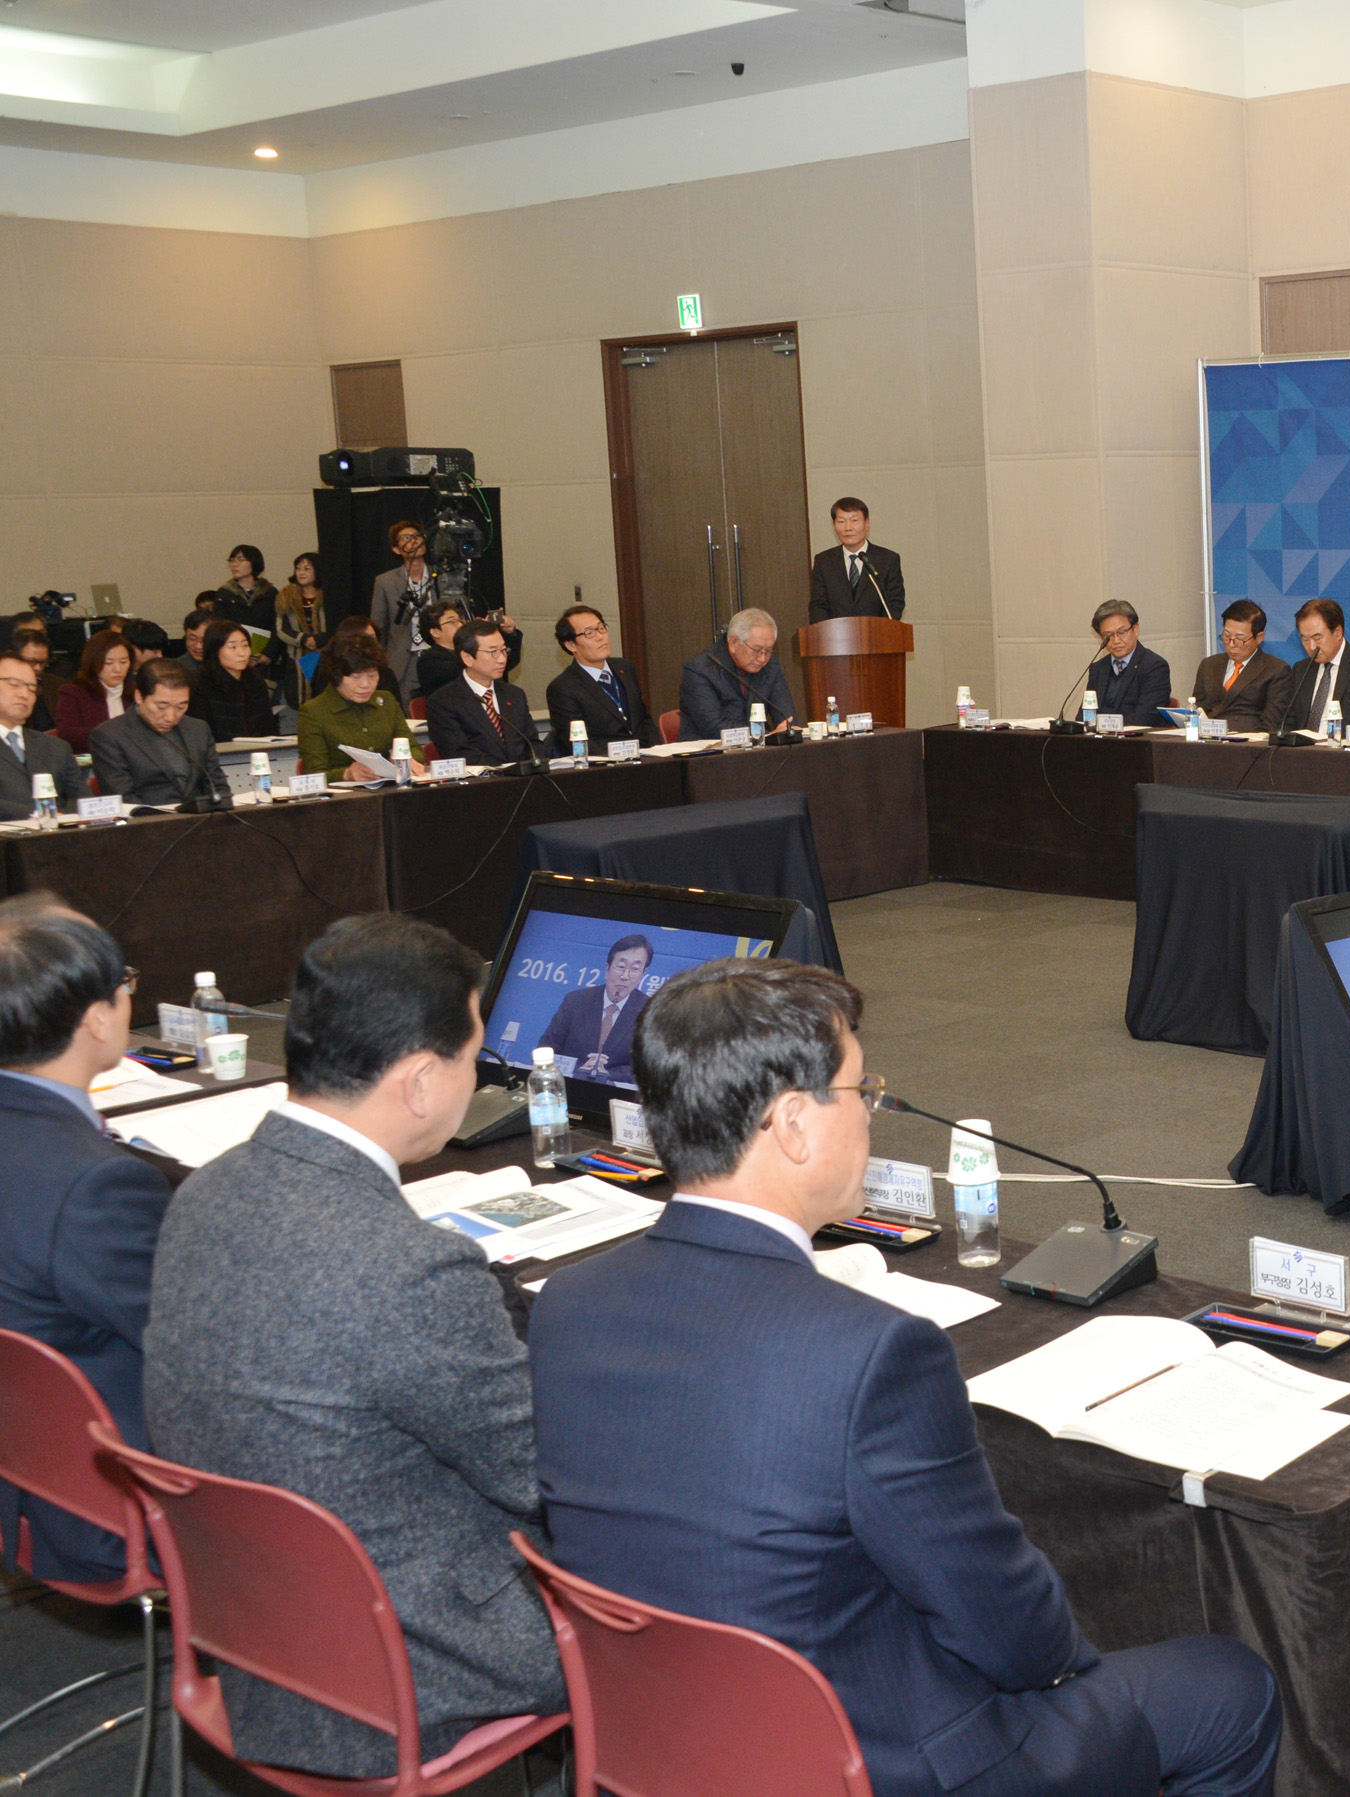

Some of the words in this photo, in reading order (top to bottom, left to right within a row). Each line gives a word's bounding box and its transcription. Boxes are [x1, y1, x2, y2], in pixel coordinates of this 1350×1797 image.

[517, 957, 569, 986] 2016.
[577, 966, 601, 988] 12
[866, 1169, 923, 1191] 산진해경제자유구역청
[1296, 1277, 1338, 1301] 김성호
